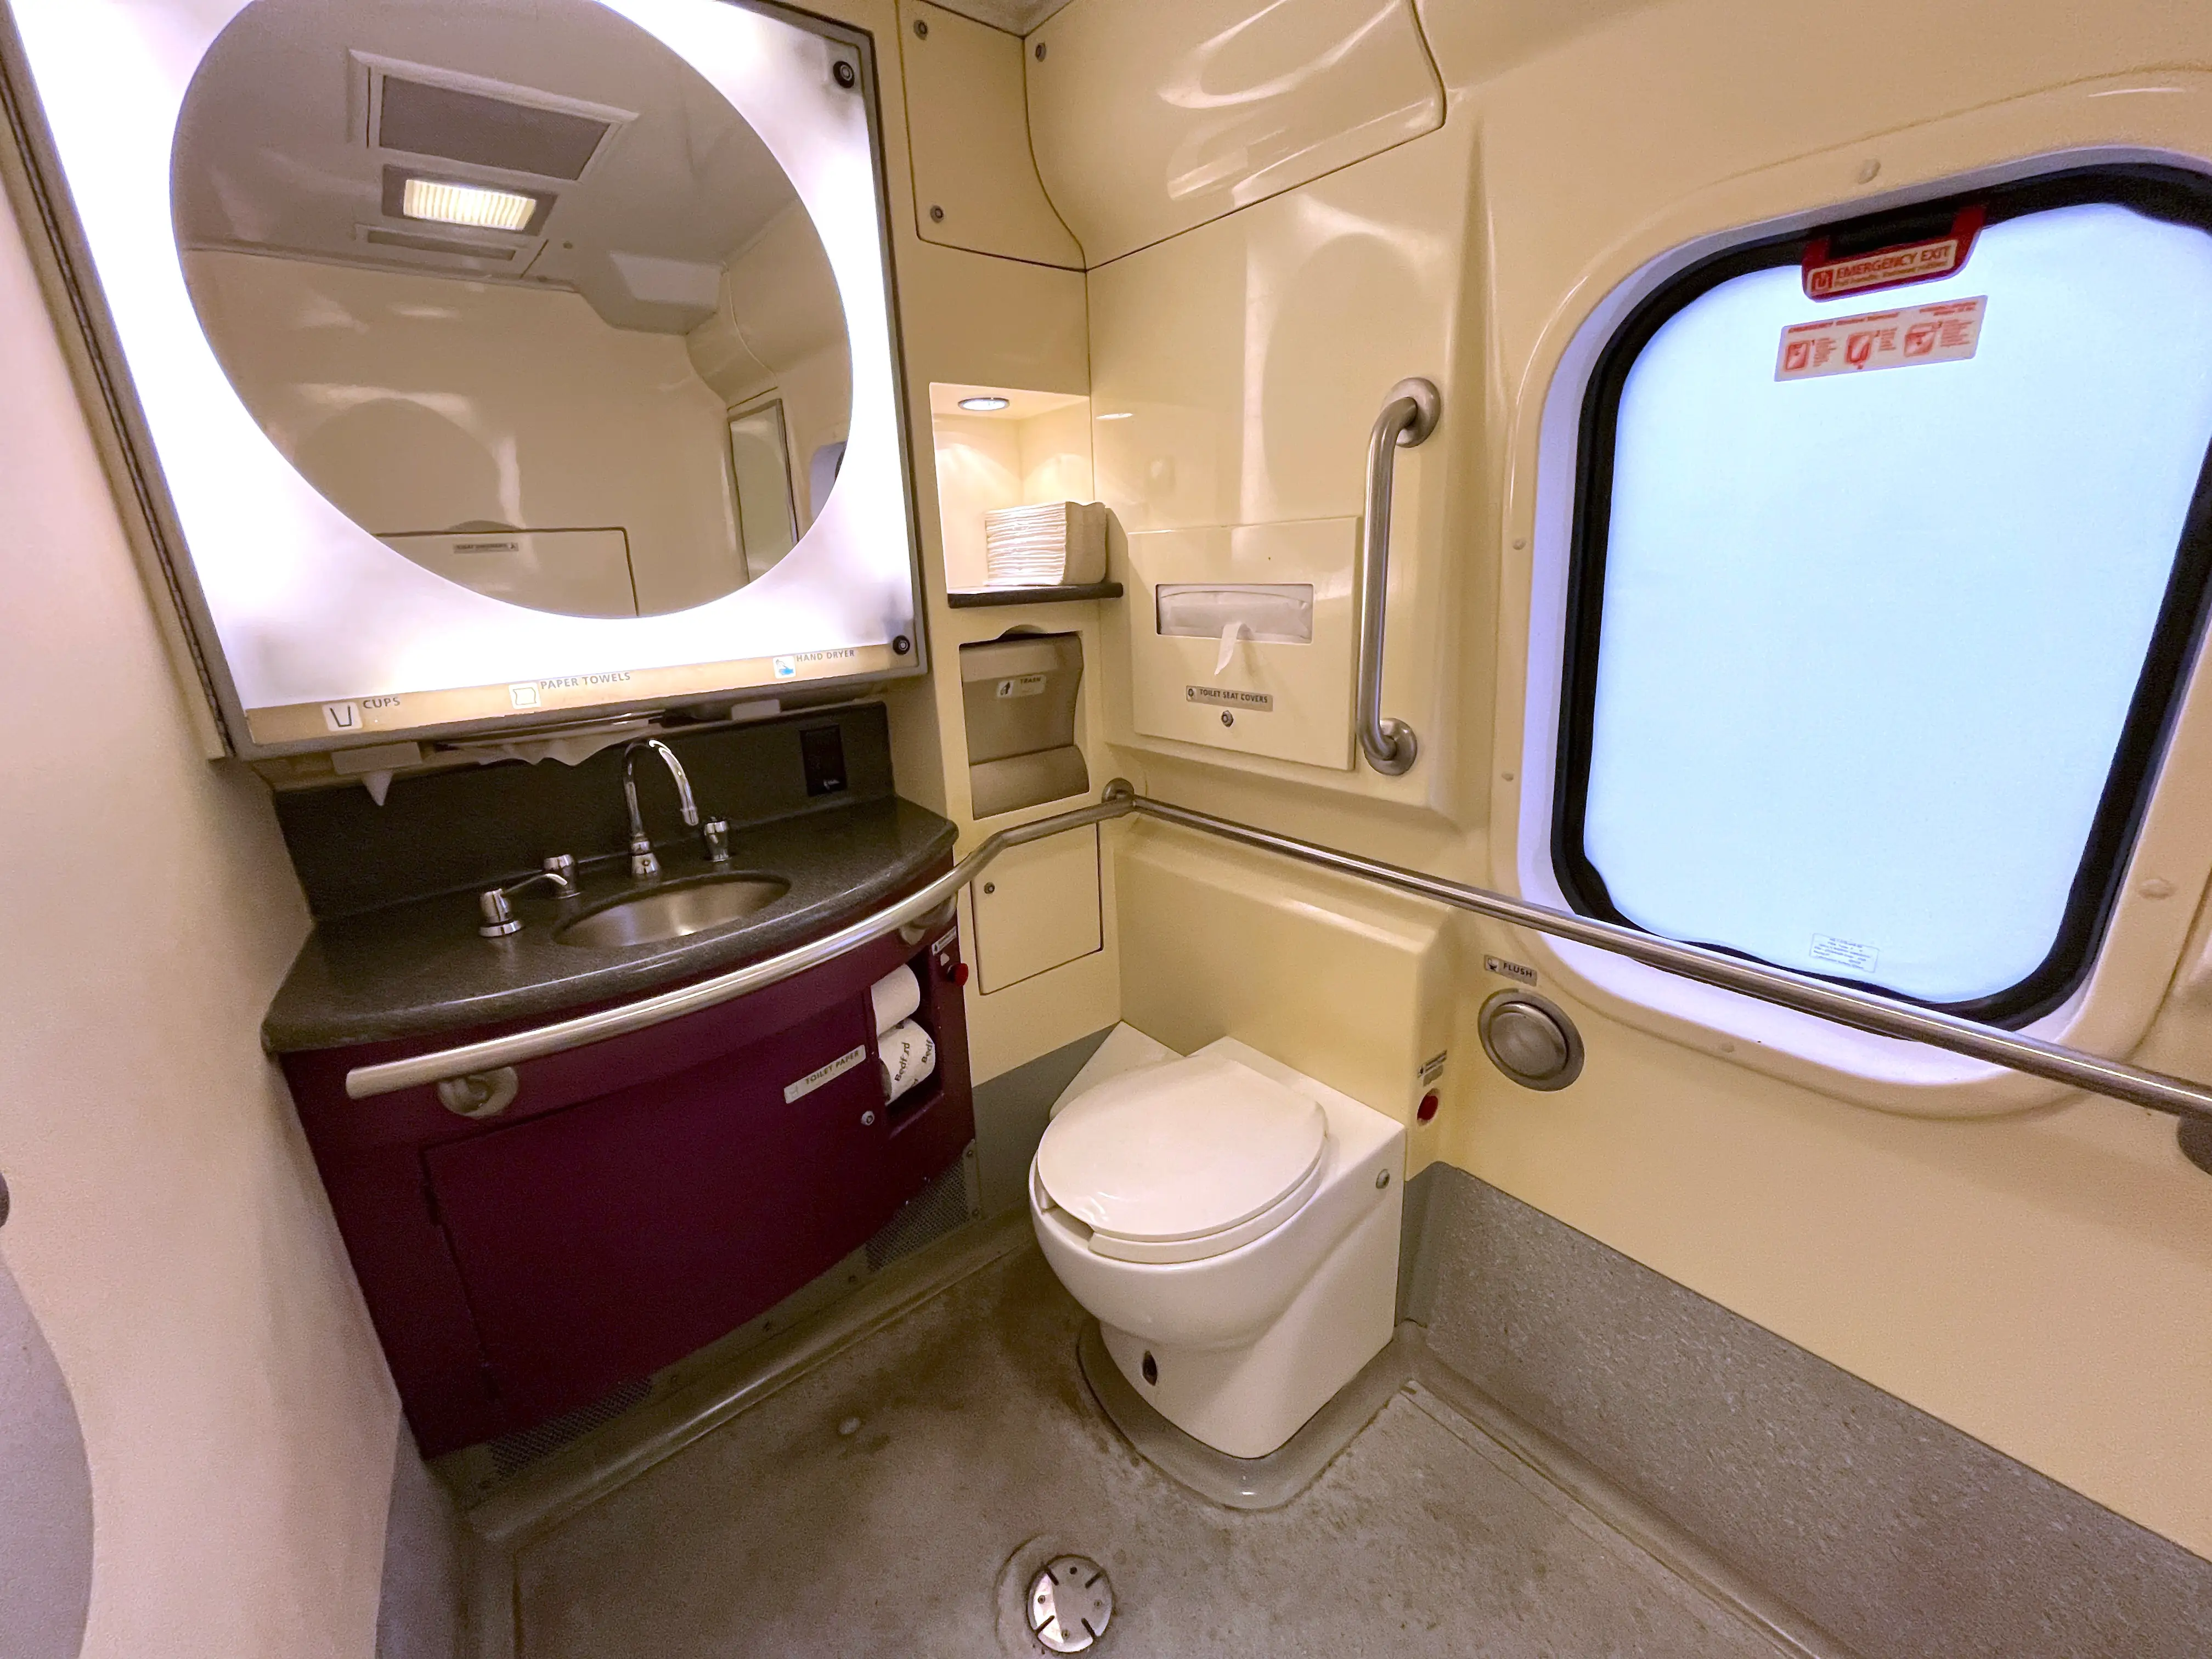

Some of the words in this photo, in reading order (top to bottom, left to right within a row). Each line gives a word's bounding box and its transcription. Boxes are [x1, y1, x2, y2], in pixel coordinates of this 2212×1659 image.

[1837, 252, 1918, 278] EMERGENCY
[1921, 245, 1952, 261] EXIT
[796, 653, 823, 662] HAND
[827, 649, 855, 659] DRYER
[540, 678, 579, 690] PAPER
[582, 672, 630, 685] TOWELS
[363, 697, 400, 709] CUPS
[1200, 689, 1221, 698] TOILET
[1223, 691, 1238, 700] SEAT
[1240, 693, 1268, 703] COVERS
[1503, 963, 1532, 978] FLUSH
[836, 1050, 859, 1068] PAPER
[894, 1042, 910, 1081] Bedfrd
